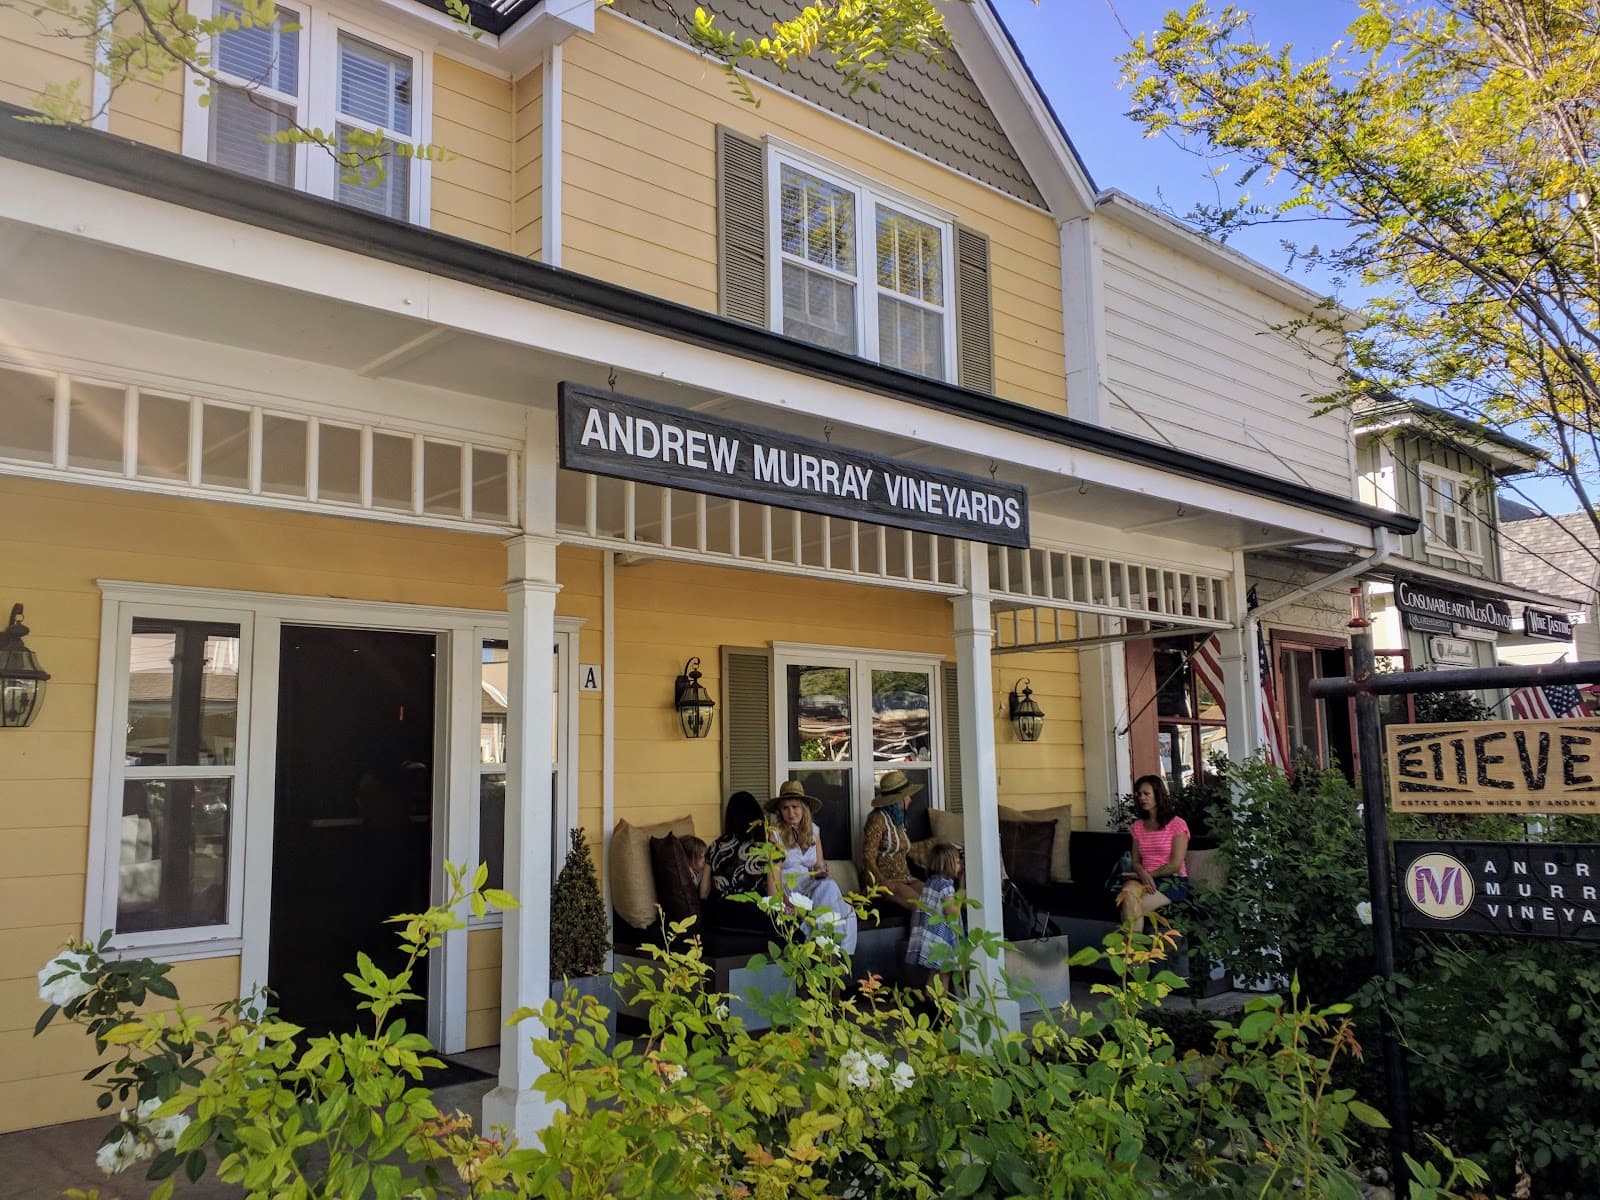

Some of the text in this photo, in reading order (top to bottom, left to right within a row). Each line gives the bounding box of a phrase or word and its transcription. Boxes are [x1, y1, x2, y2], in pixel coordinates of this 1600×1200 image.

[580, 407, 1021, 530] ANDREW MURRAY VINEYARDS
[584, 666, 598, 689] A
[1401, 799, 1596, 807] ESTATE GROWN WINES BY ANDREW
[1484, 860, 1591, 877] ANDR
[1486, 881, 1597, 900] MURR
[1487, 904, 1597, 923] VINEYA
